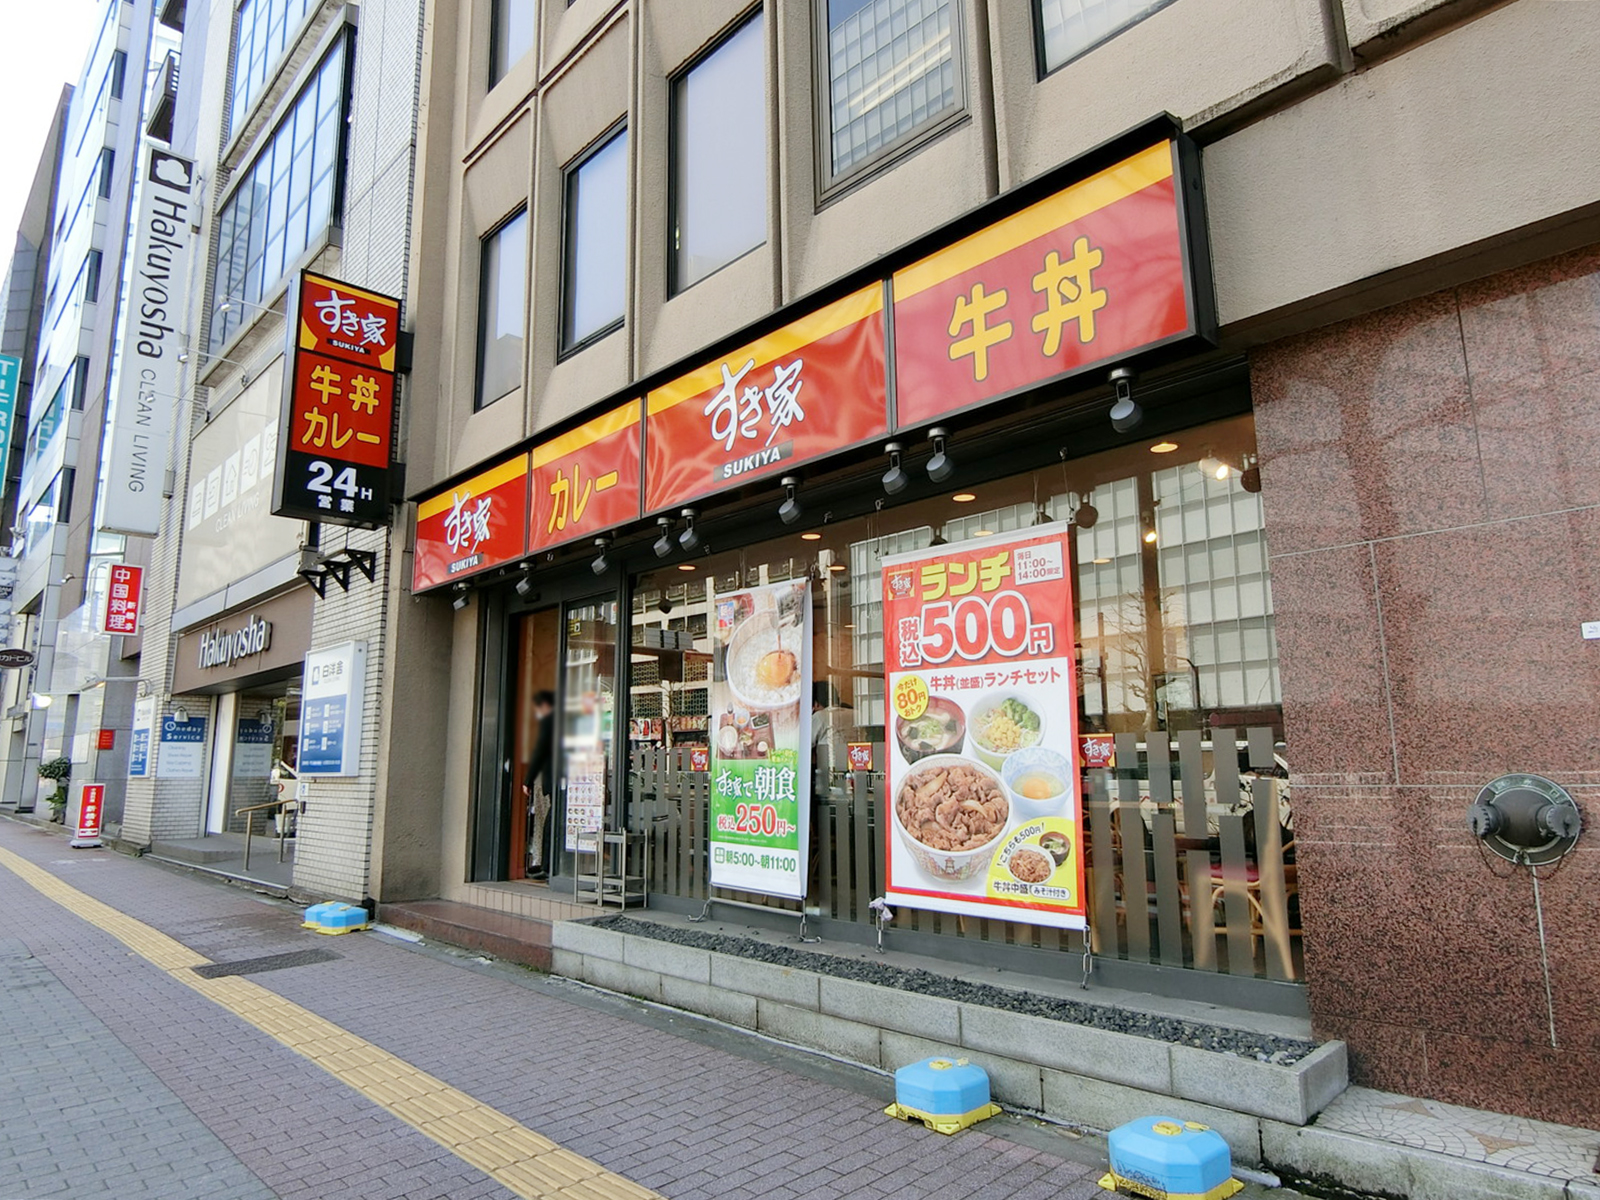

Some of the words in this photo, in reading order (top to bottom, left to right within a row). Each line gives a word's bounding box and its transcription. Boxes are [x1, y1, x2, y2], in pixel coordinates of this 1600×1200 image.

[137, 195, 188, 359] Hakuyosha
[314, 289, 387, 347] すき家
[948, 236, 1108, 382] 牛丼
[331, 339, 366, 355] SUKIYA
[136, 368, 157, 427] CLEAN
[310, 364, 380, 416] 牛丼
[703, 357, 806, 452] すき家
[301, 406, 381, 450] カレー
[128, 434, 149, 493] LIVING
[722, 446, 782, 479] SUKIYA
[318, 494, 355, 514] 営業
[547, 464, 618, 535] カレー
[443, 491, 492, 555] すき家
[450, 555, 479, 574] SUKIYA
[920, 551, 1012, 602] ランチ
[1017, 550, 1031, 561] 毎日
[109, 568, 131, 630] 中国料理
[198, 613, 267, 669] Hakuyosha
[899, 617, 921, 666] 税込
[920, 591, 1053, 663] 500円
[896, 688, 926, 709] 80円
[897, 677, 918, 691] 今だけ
[904, 705, 922, 717] おトク
[166, 732, 201, 741] Service
[850, 745, 870, 762] すき家
[1082, 738, 1111, 759] すき家
[993, 881, 1029, 895] 牛丼中盛
[1033, 886, 1066, 898] みそ汁付き
